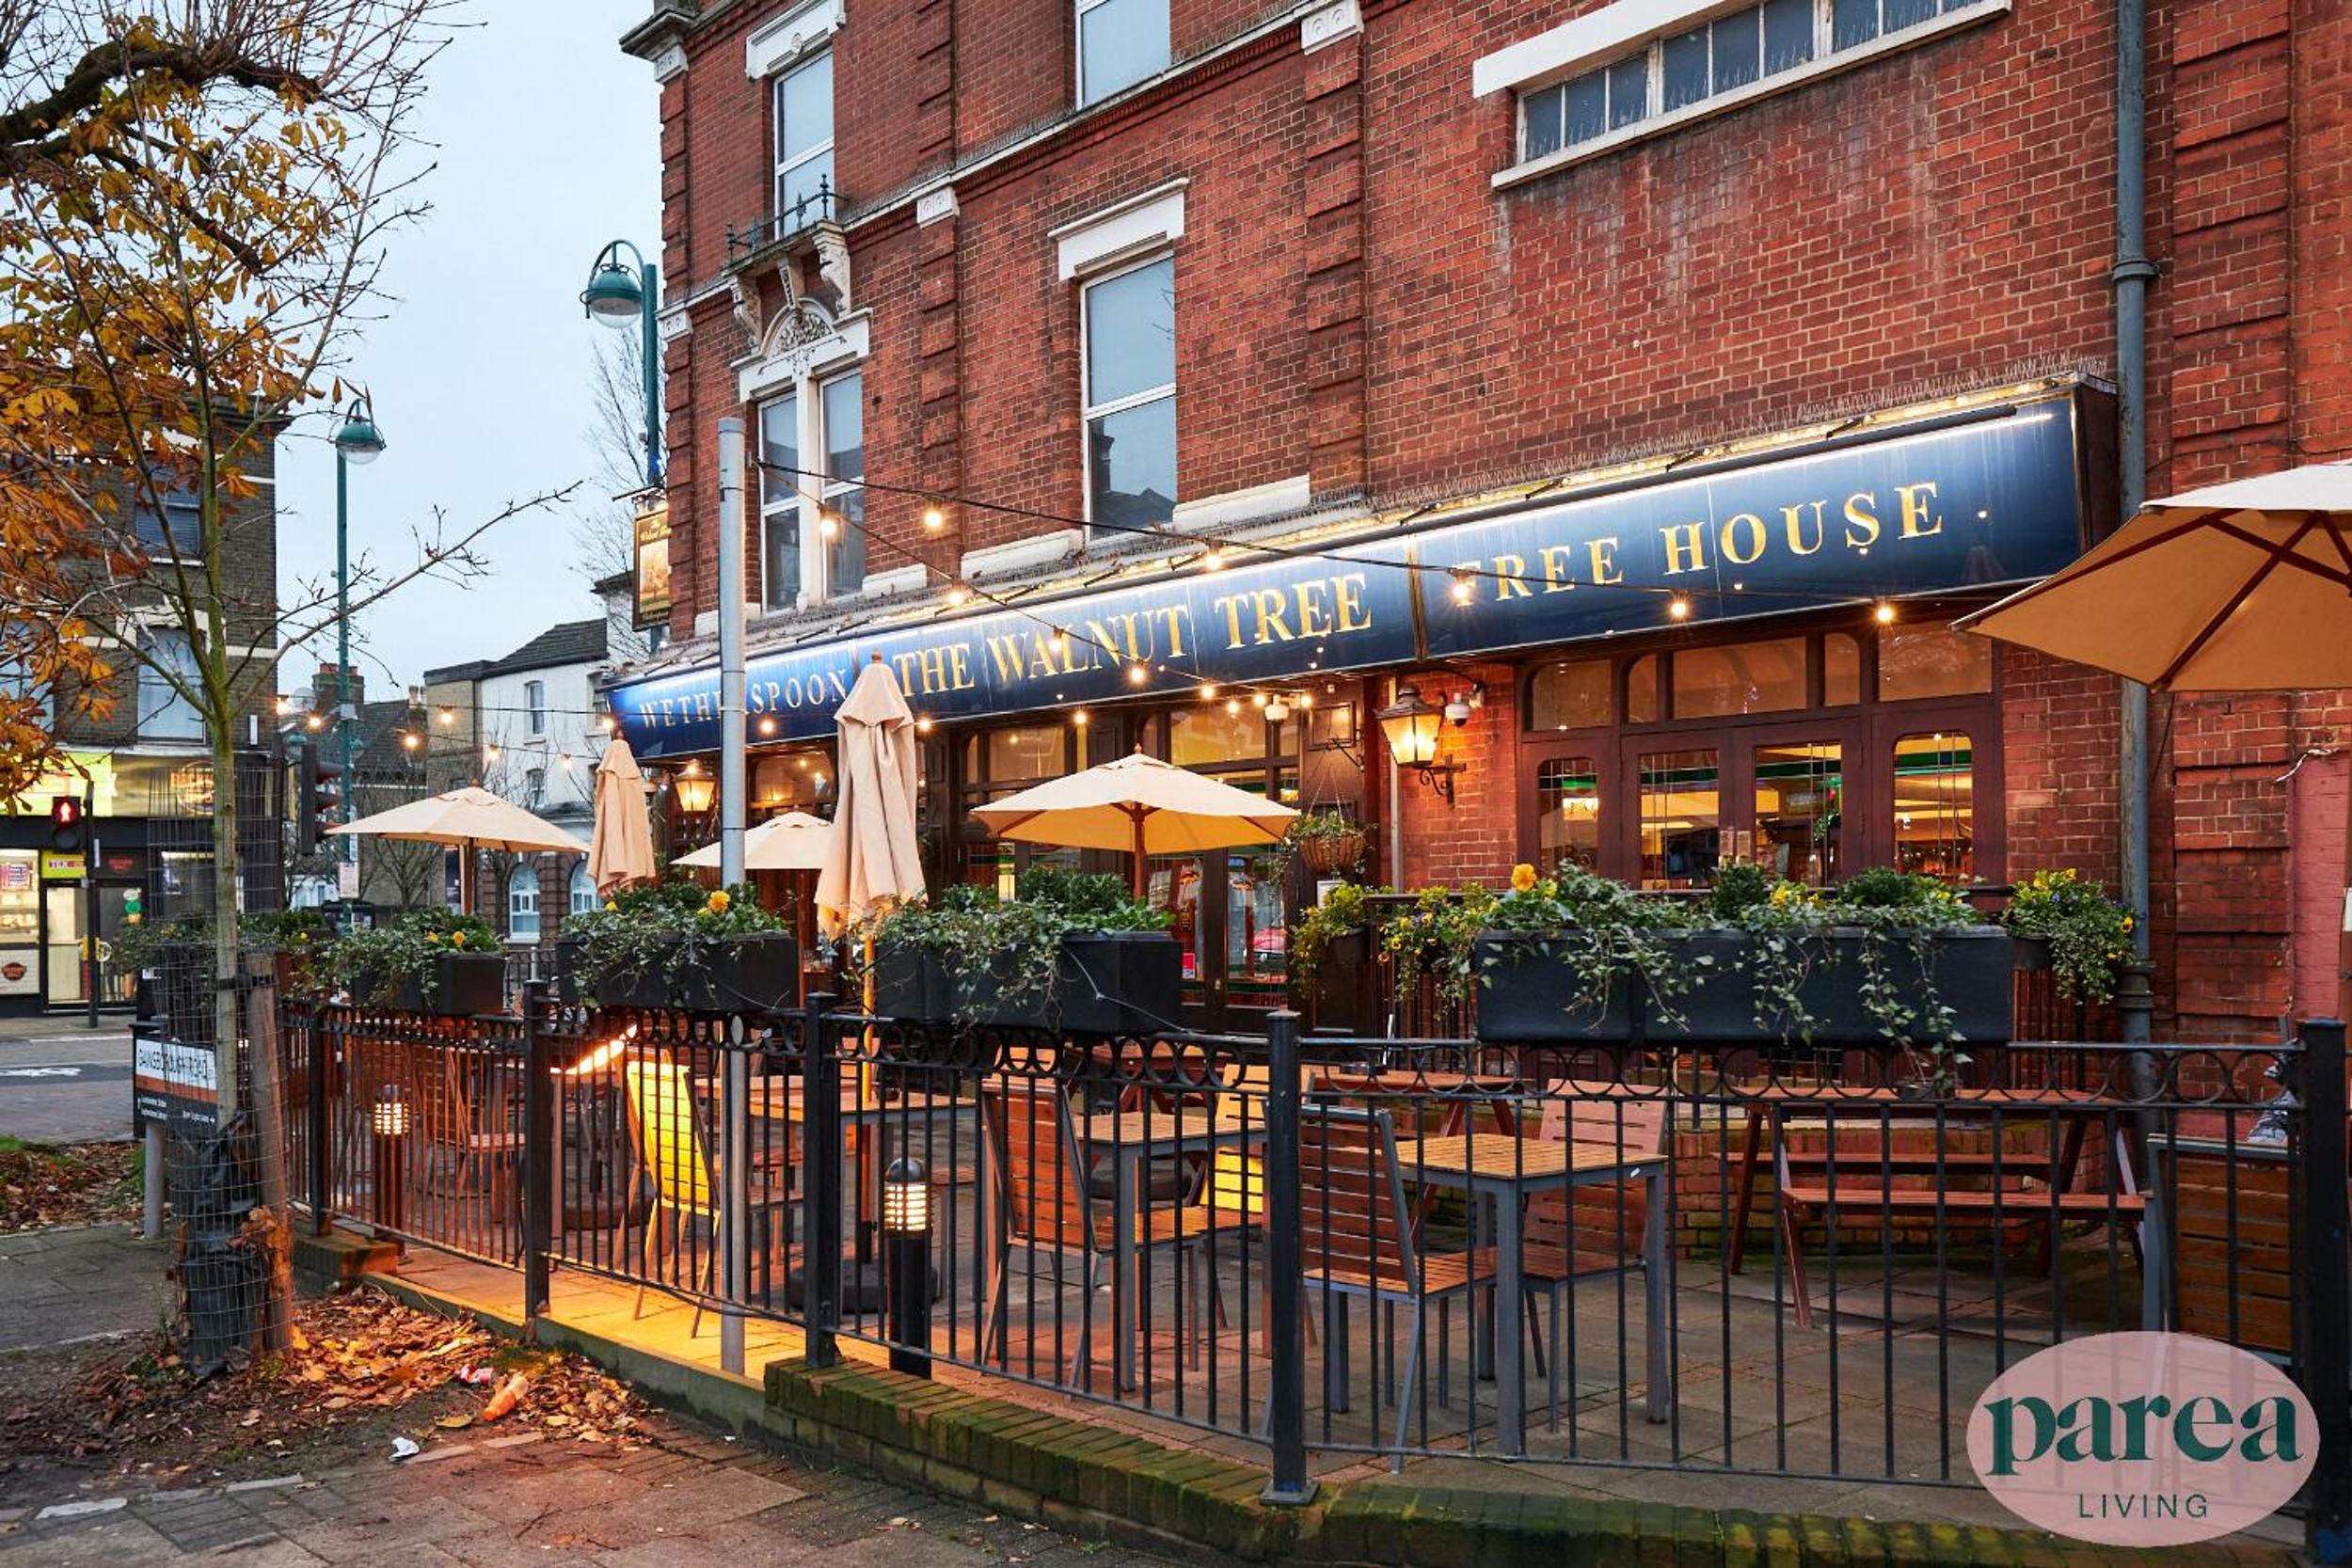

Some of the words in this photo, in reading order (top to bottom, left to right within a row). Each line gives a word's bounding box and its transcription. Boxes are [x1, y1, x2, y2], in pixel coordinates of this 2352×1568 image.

[1658, 481, 1943, 577] HOUSE
[892, 642, 976, 698] THE
[986, 603, 1189, 684] WALNUT
[1214, 572, 1373, 651] TREE
[639, 669, 848, 729] WETHSPOON
